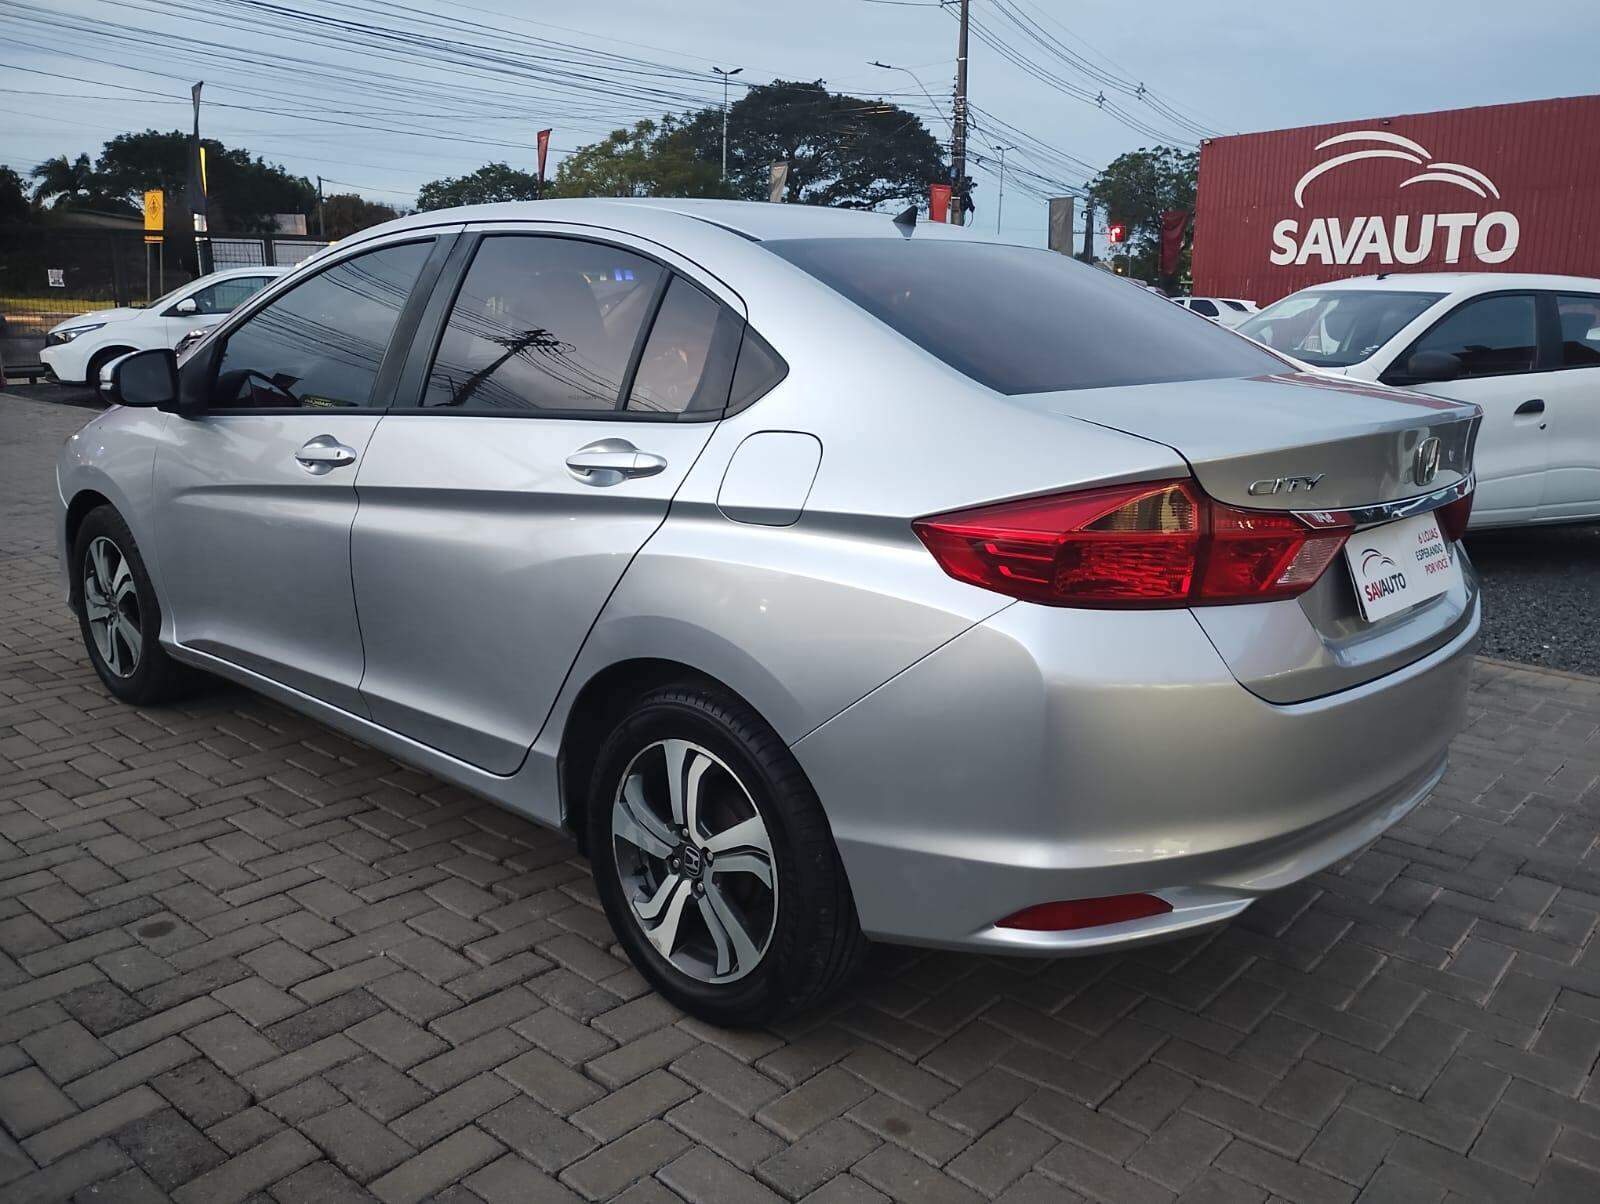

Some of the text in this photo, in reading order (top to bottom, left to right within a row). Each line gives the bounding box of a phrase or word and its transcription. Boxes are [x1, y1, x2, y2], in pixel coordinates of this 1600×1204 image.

[1269, 211, 1520, 265] SAVAUTO
[1248, 473, 1326, 496] CITY
[1422, 528, 1439, 543] LOJAS
[1415, 543, 1444, 561] ESPERANDO
[1424, 562, 1436, 575] POR
[1365, 573, 1406, 602] SAVAUTO
